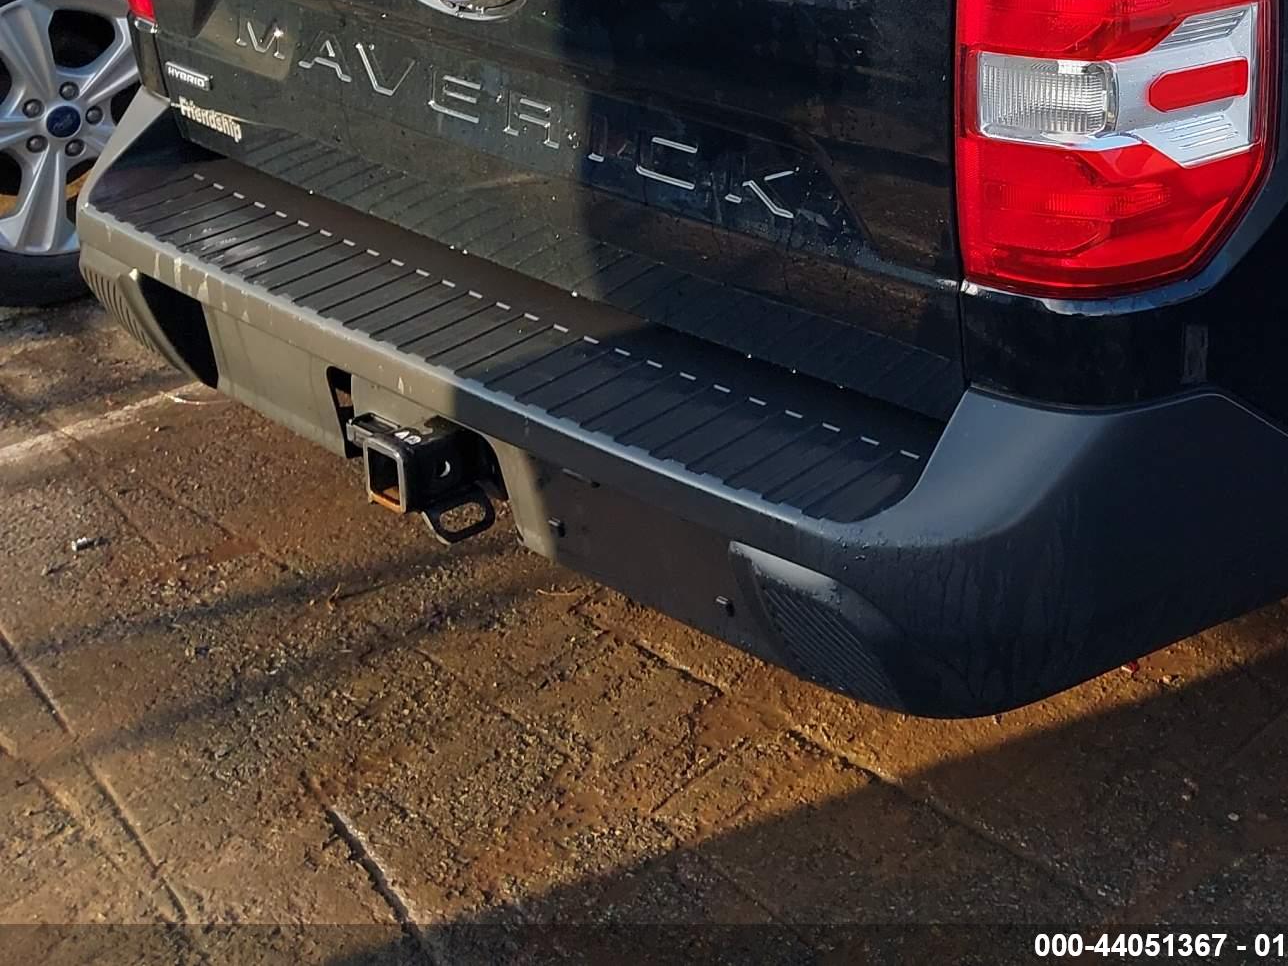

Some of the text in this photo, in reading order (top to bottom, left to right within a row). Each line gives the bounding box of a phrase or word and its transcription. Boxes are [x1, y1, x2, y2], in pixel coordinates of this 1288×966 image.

[167, 65, 206, 88] HYBRID
[178, 95, 243, 144] Friendship
[234, 15, 798, 220] MAVERICK
